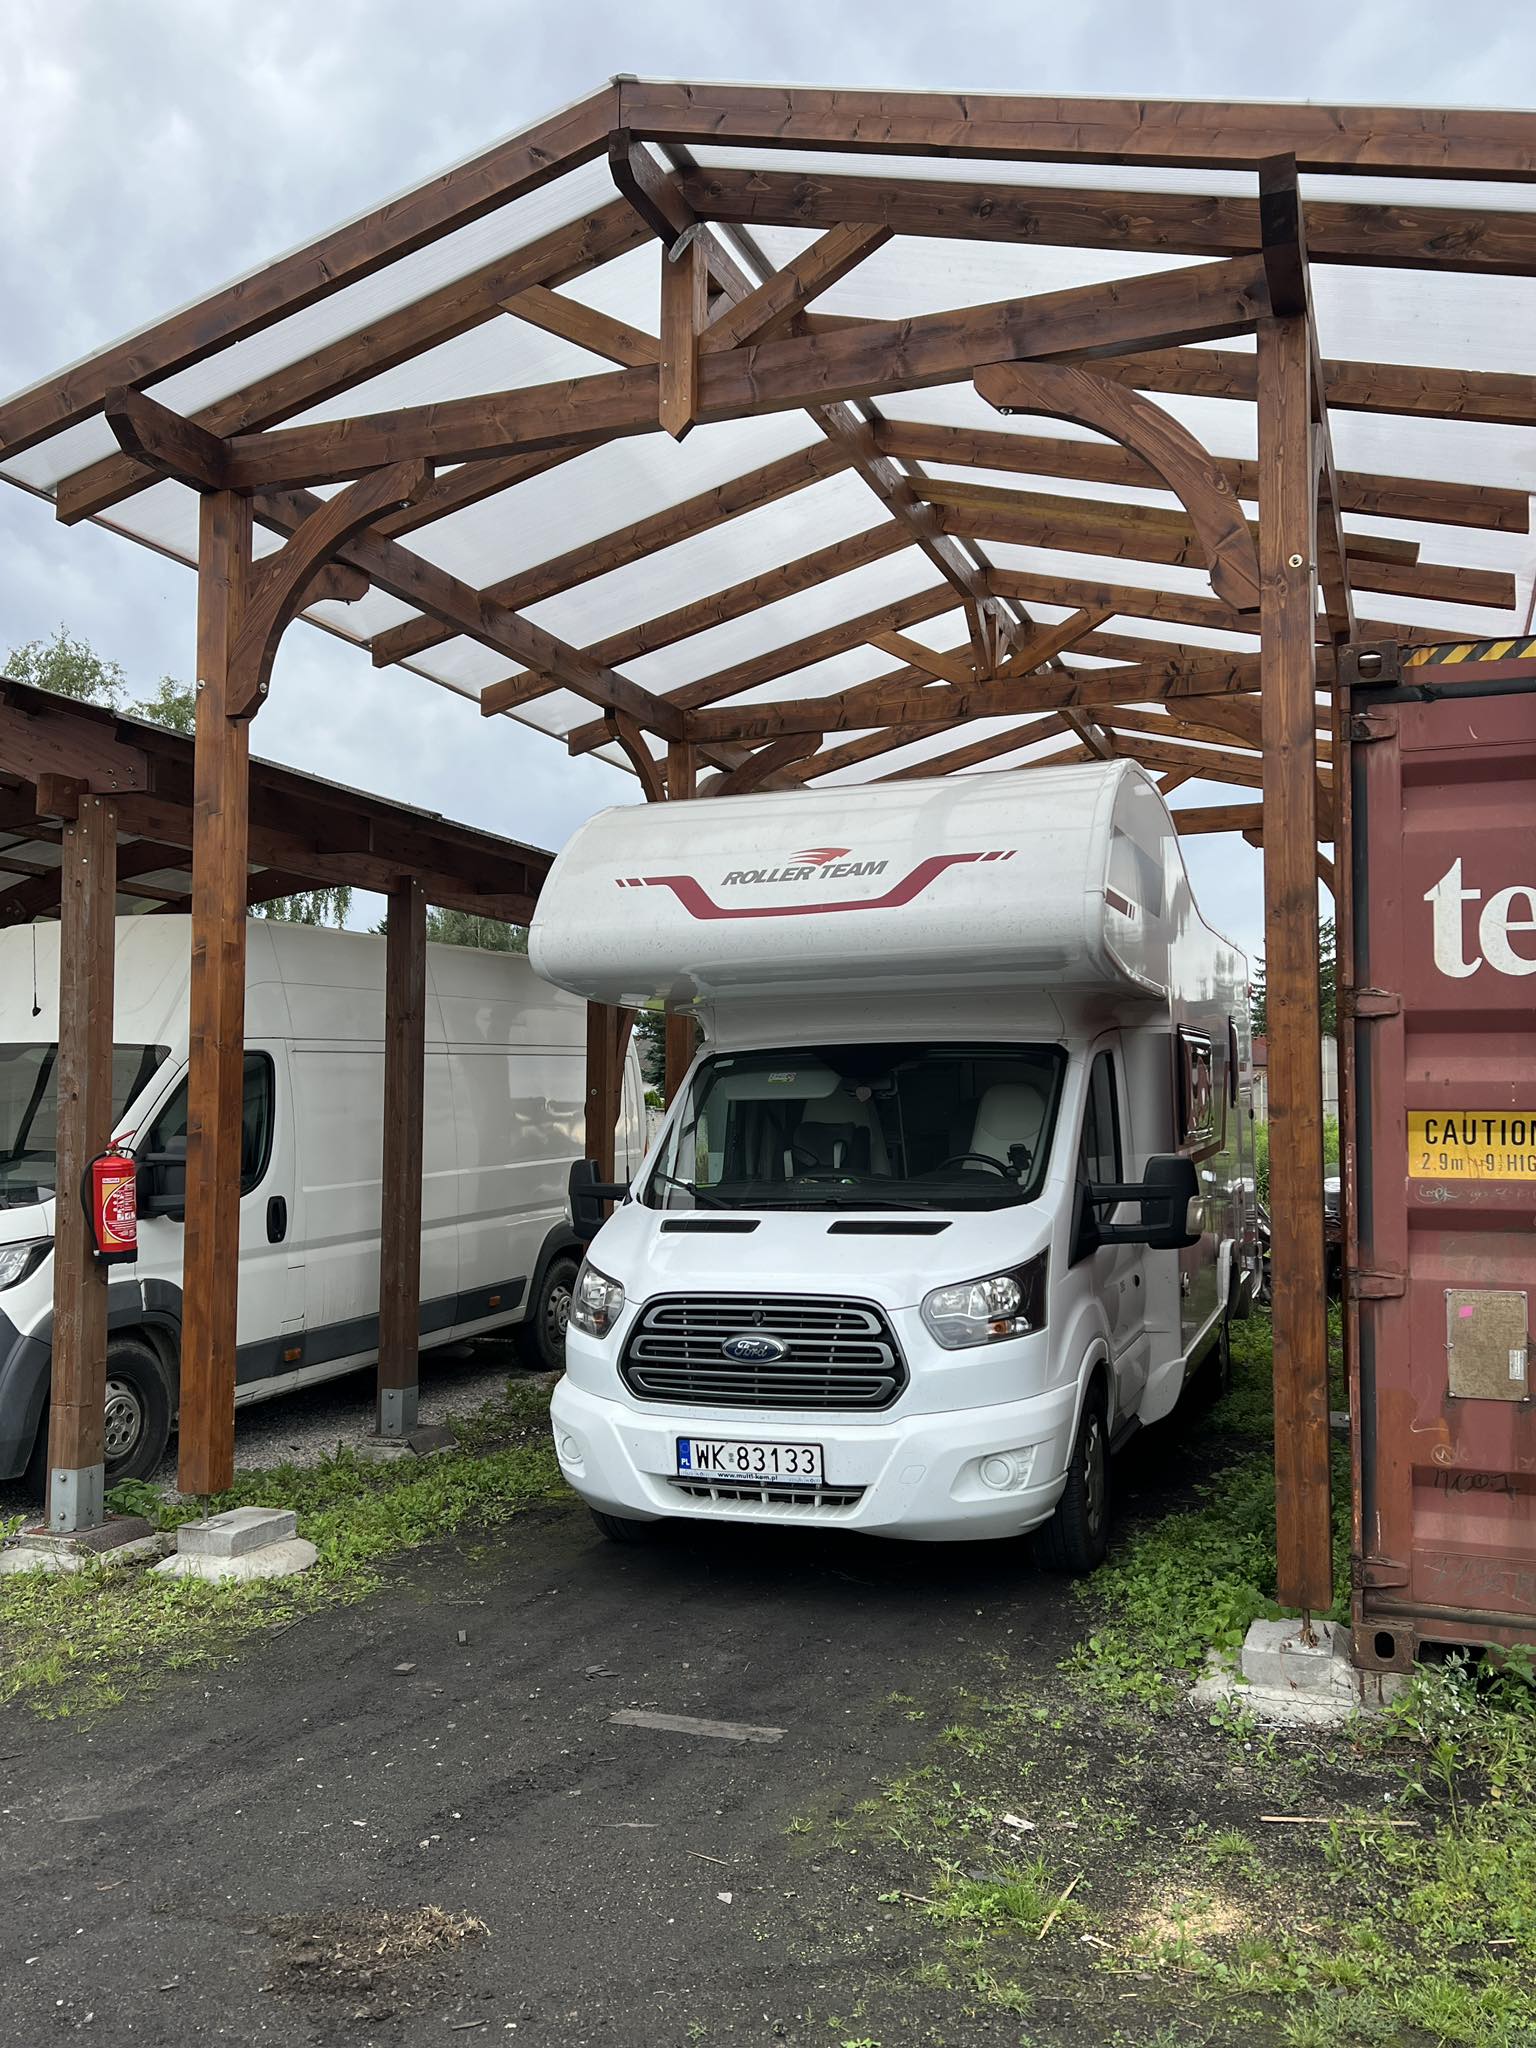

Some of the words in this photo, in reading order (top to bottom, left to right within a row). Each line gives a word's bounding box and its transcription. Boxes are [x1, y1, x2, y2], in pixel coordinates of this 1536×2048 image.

[721, 865, 816, 886] ROLLER
[819, 860, 889, 879] TEAM
[734, 1340, 768, 1357] Ford
[681, 1458, 690, 1466] PL
[696, 1444, 726, 1470] WK
[737, 1446, 815, 1474] 83133
